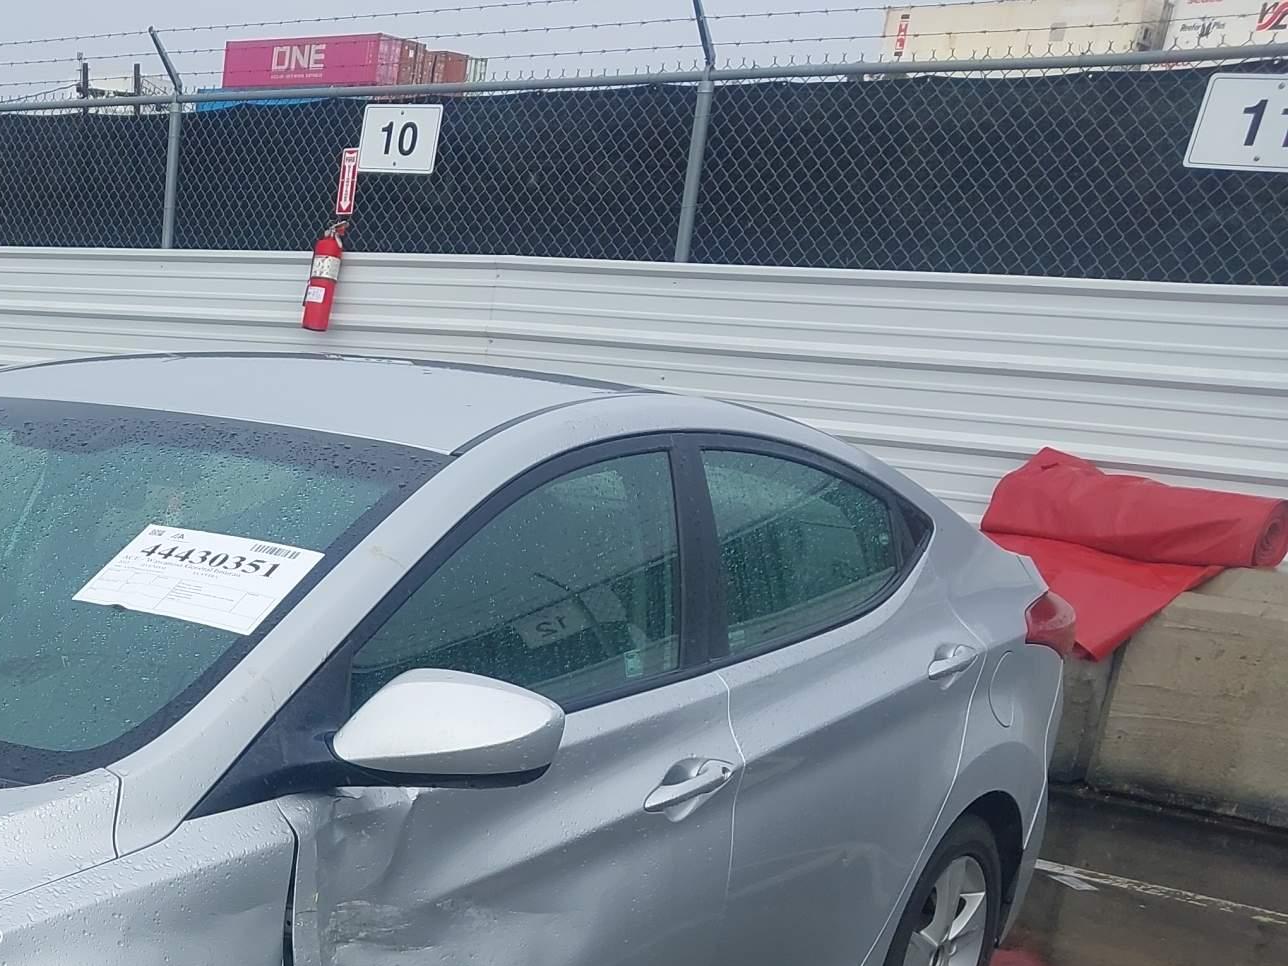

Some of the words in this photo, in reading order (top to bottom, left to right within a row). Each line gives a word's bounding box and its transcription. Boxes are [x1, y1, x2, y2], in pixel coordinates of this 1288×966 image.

[271, 44, 327, 71] ONE
[381, 121, 418, 157] 10
[1242, 98, 1288, 148] 1
[141, 543, 281, 578] 44430351
